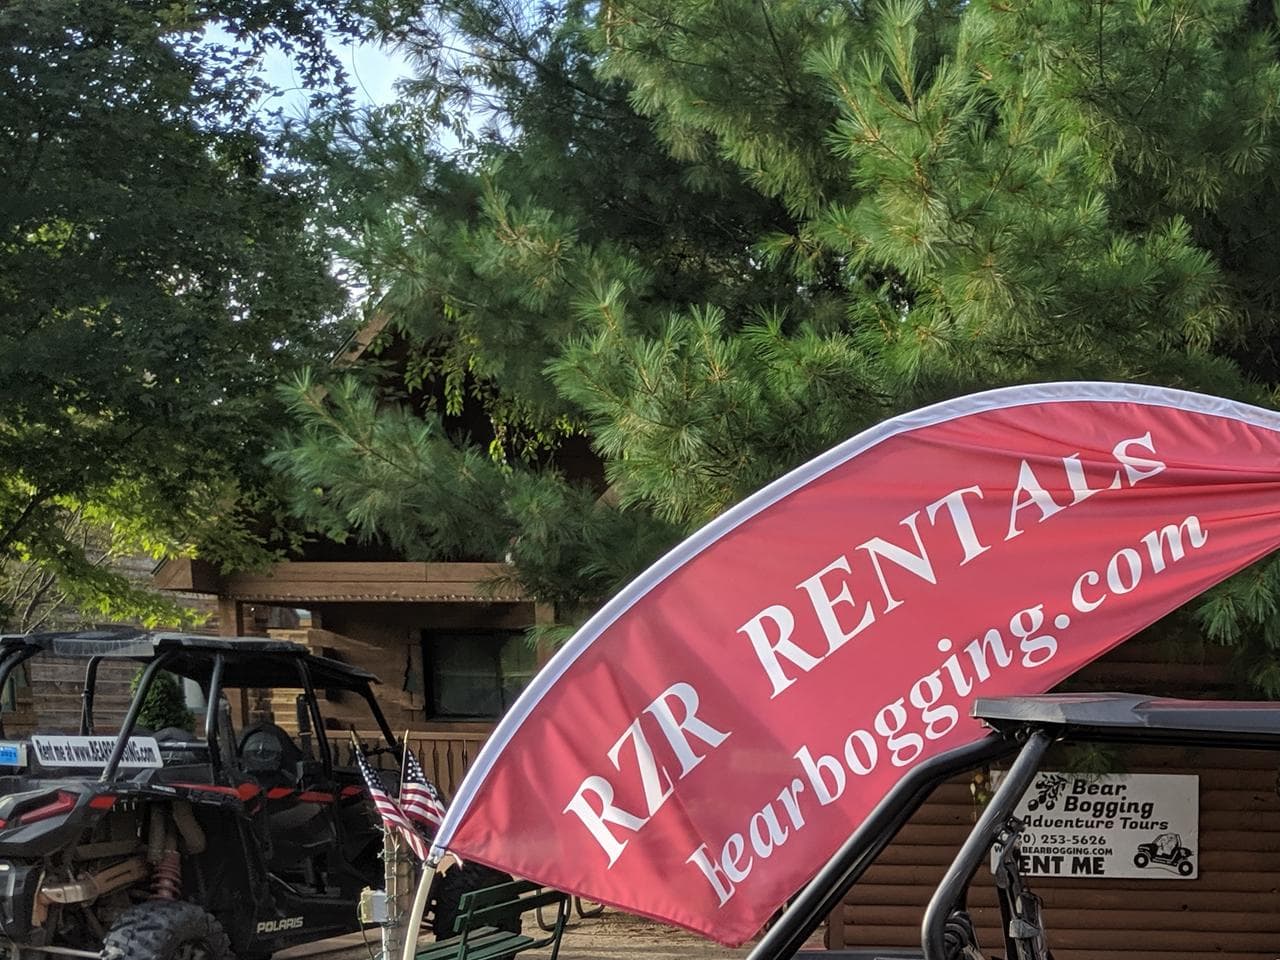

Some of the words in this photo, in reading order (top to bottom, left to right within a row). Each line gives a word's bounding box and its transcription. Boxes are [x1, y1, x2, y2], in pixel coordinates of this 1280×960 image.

[563, 682, 733, 870] RZR
[736, 431, 1167, 699] RENTALS
[685, 515, 1208, 909] bearbogging.com
[1071, 779, 1127, 796] Bear
[1063, 795, 1154, 818] Bogging
[1022, 815, 1114, 829] Adventure
[1120, 817, 1169, 831] Tours
[1041, 834, 1106, 846] 253-5626
[1018, 855, 1064, 874] ENT
[1071, 856, 1105, 875] ME
[256, 916, 304, 933] POLARIS
